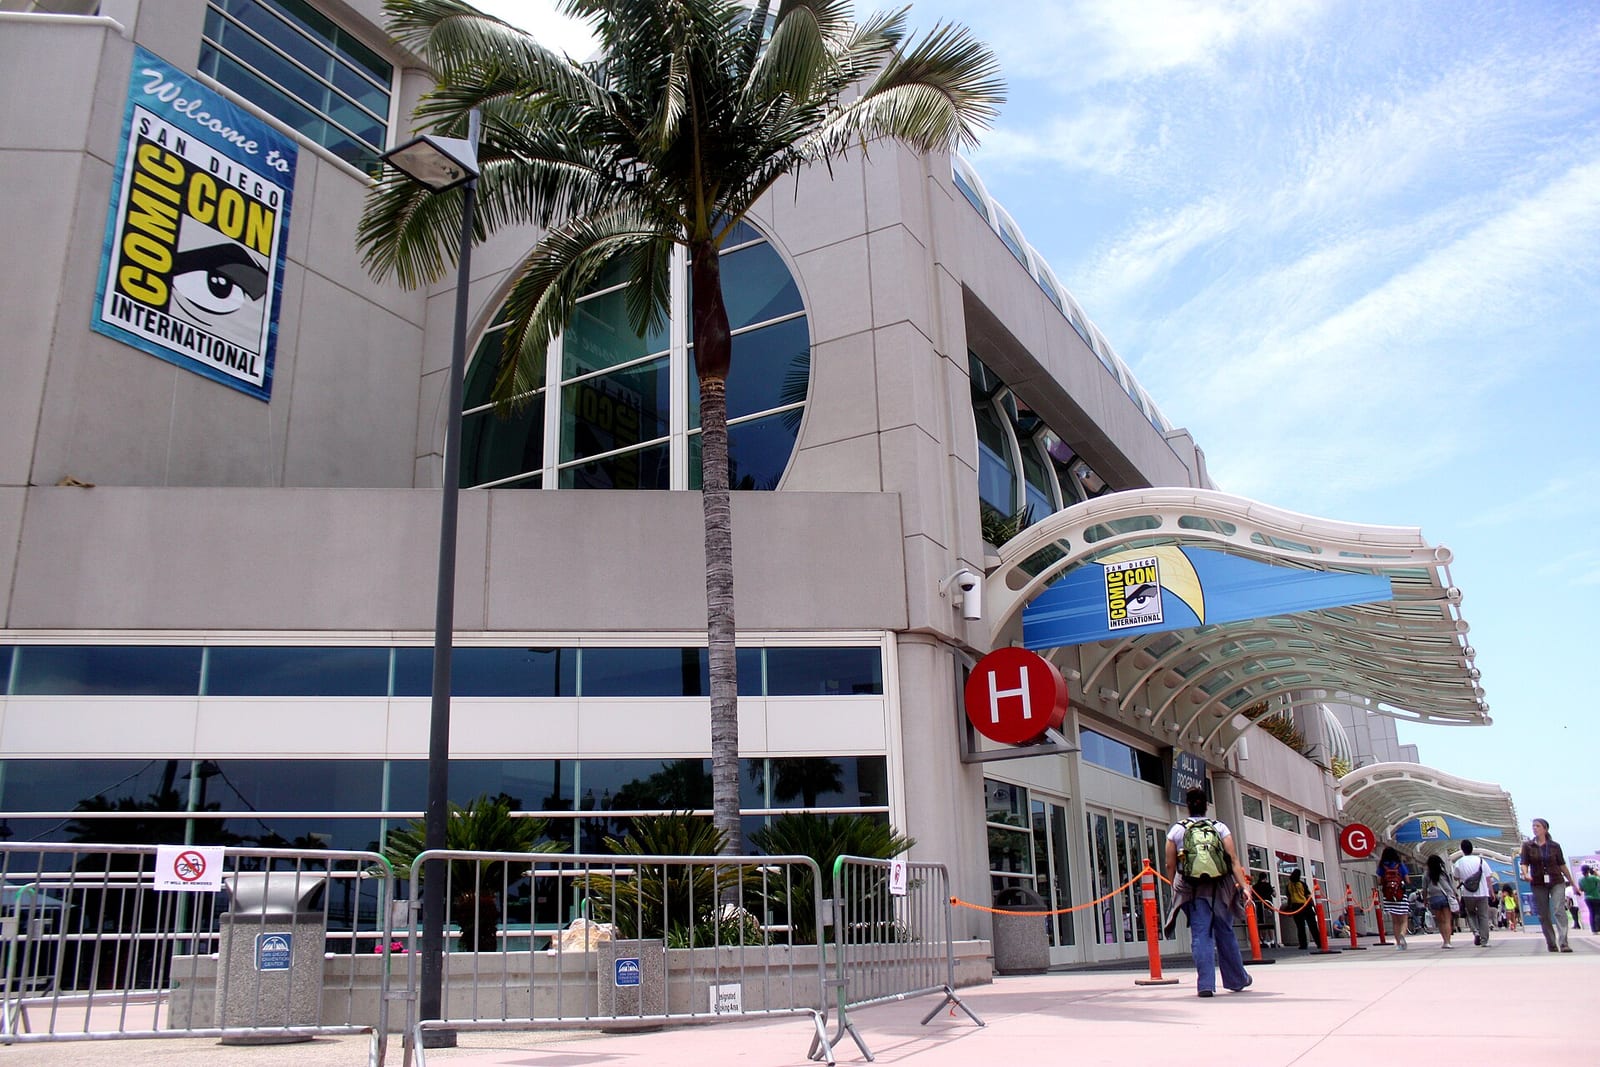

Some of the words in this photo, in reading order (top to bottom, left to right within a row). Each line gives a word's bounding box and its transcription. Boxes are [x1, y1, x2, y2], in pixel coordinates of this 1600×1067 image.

[141, 68, 258, 155] Welcome
[265, 147, 290, 173] to
[139, 117, 187, 157] SAN
[209, 157, 279, 208] DIEGO
[119, 143, 186, 307] COMIC
[187, 171, 275, 257] CON
[110, 293, 259, 378] INTERNATIONAL
[1106, 565, 1122, 573] SAN
[1129, 559, 1155, 568] DIEGO
[1124, 566, 1156, 586] CON
[1108, 572, 1126, 619] COMIC
[1110, 614, 1160, 627] INTERNATIONAL
[987, 665, 1032, 723] H
[1348, 830, 1368, 850] G
